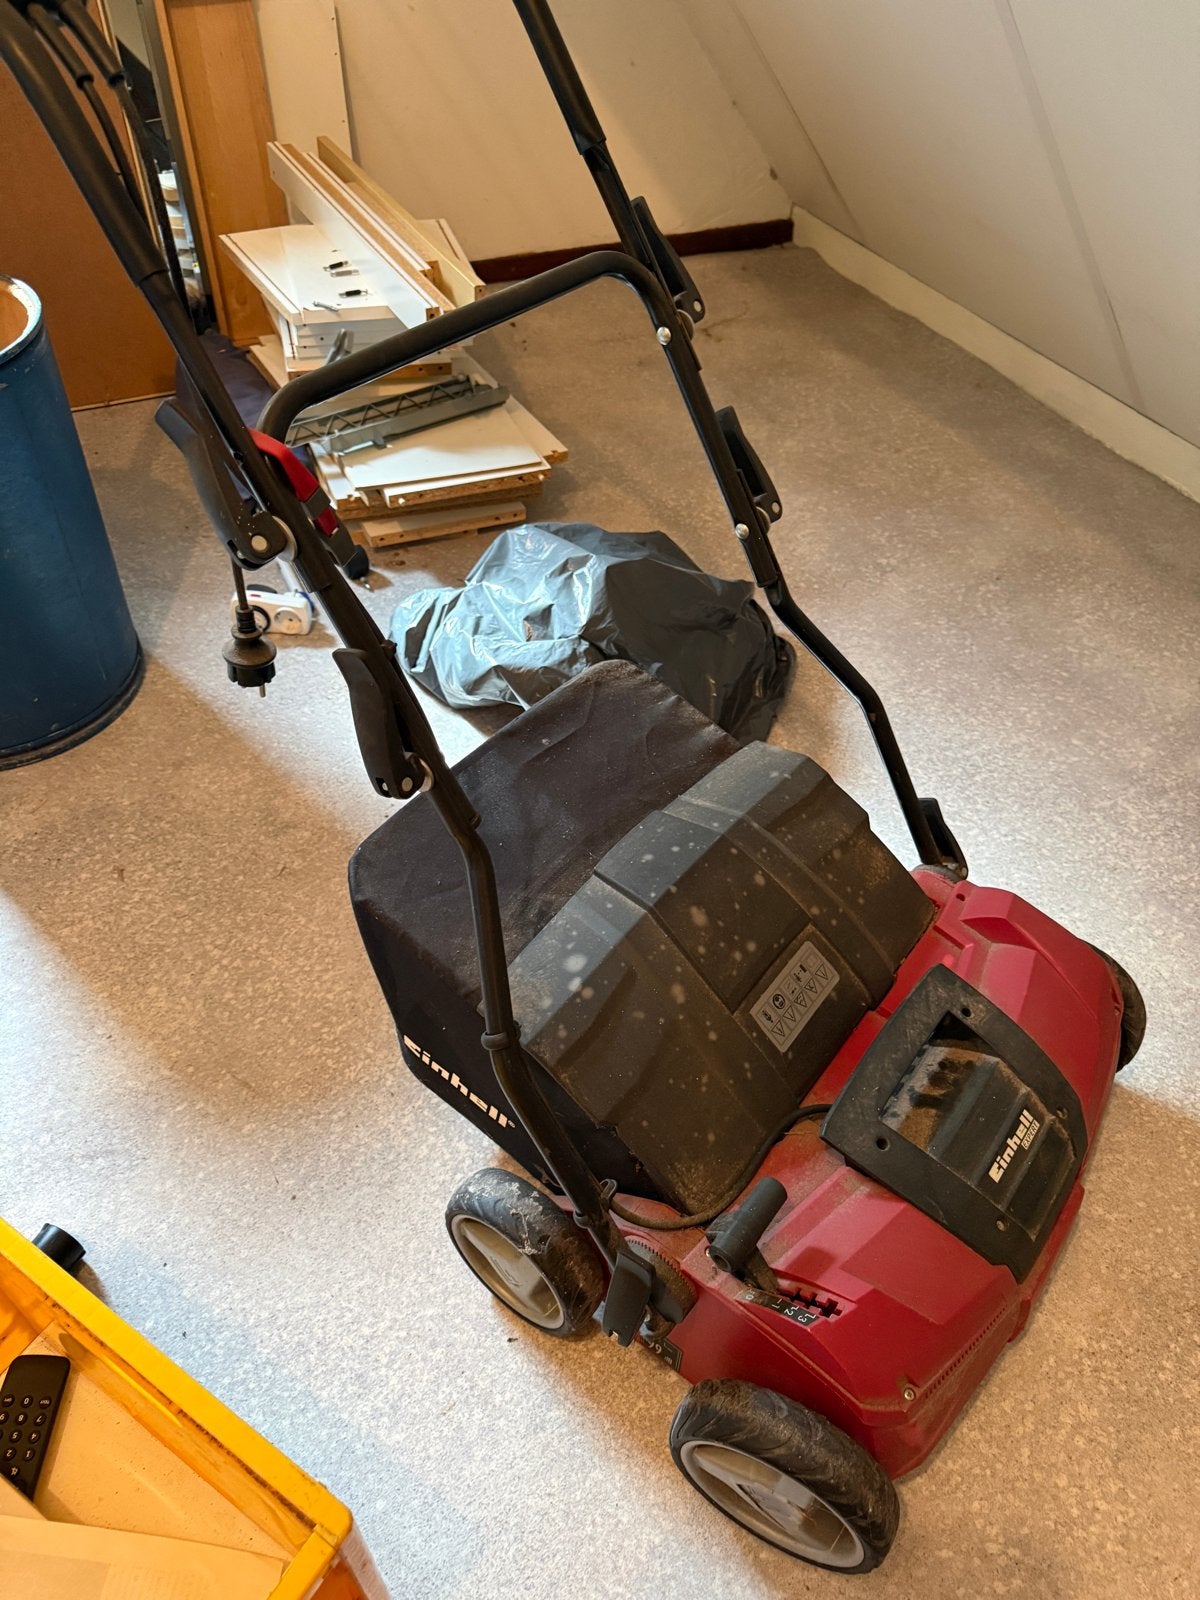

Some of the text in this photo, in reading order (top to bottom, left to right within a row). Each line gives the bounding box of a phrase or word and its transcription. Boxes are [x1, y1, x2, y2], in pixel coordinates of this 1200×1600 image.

[403, 1034, 508, 1128] Einhell
[988, 1108, 1034, 1183] Einhell
[1021, 1120, 1040, 1150] EXPERT
[783, 1308, 794, 1317] 2
[797, 1315, 807, 1323] 3
